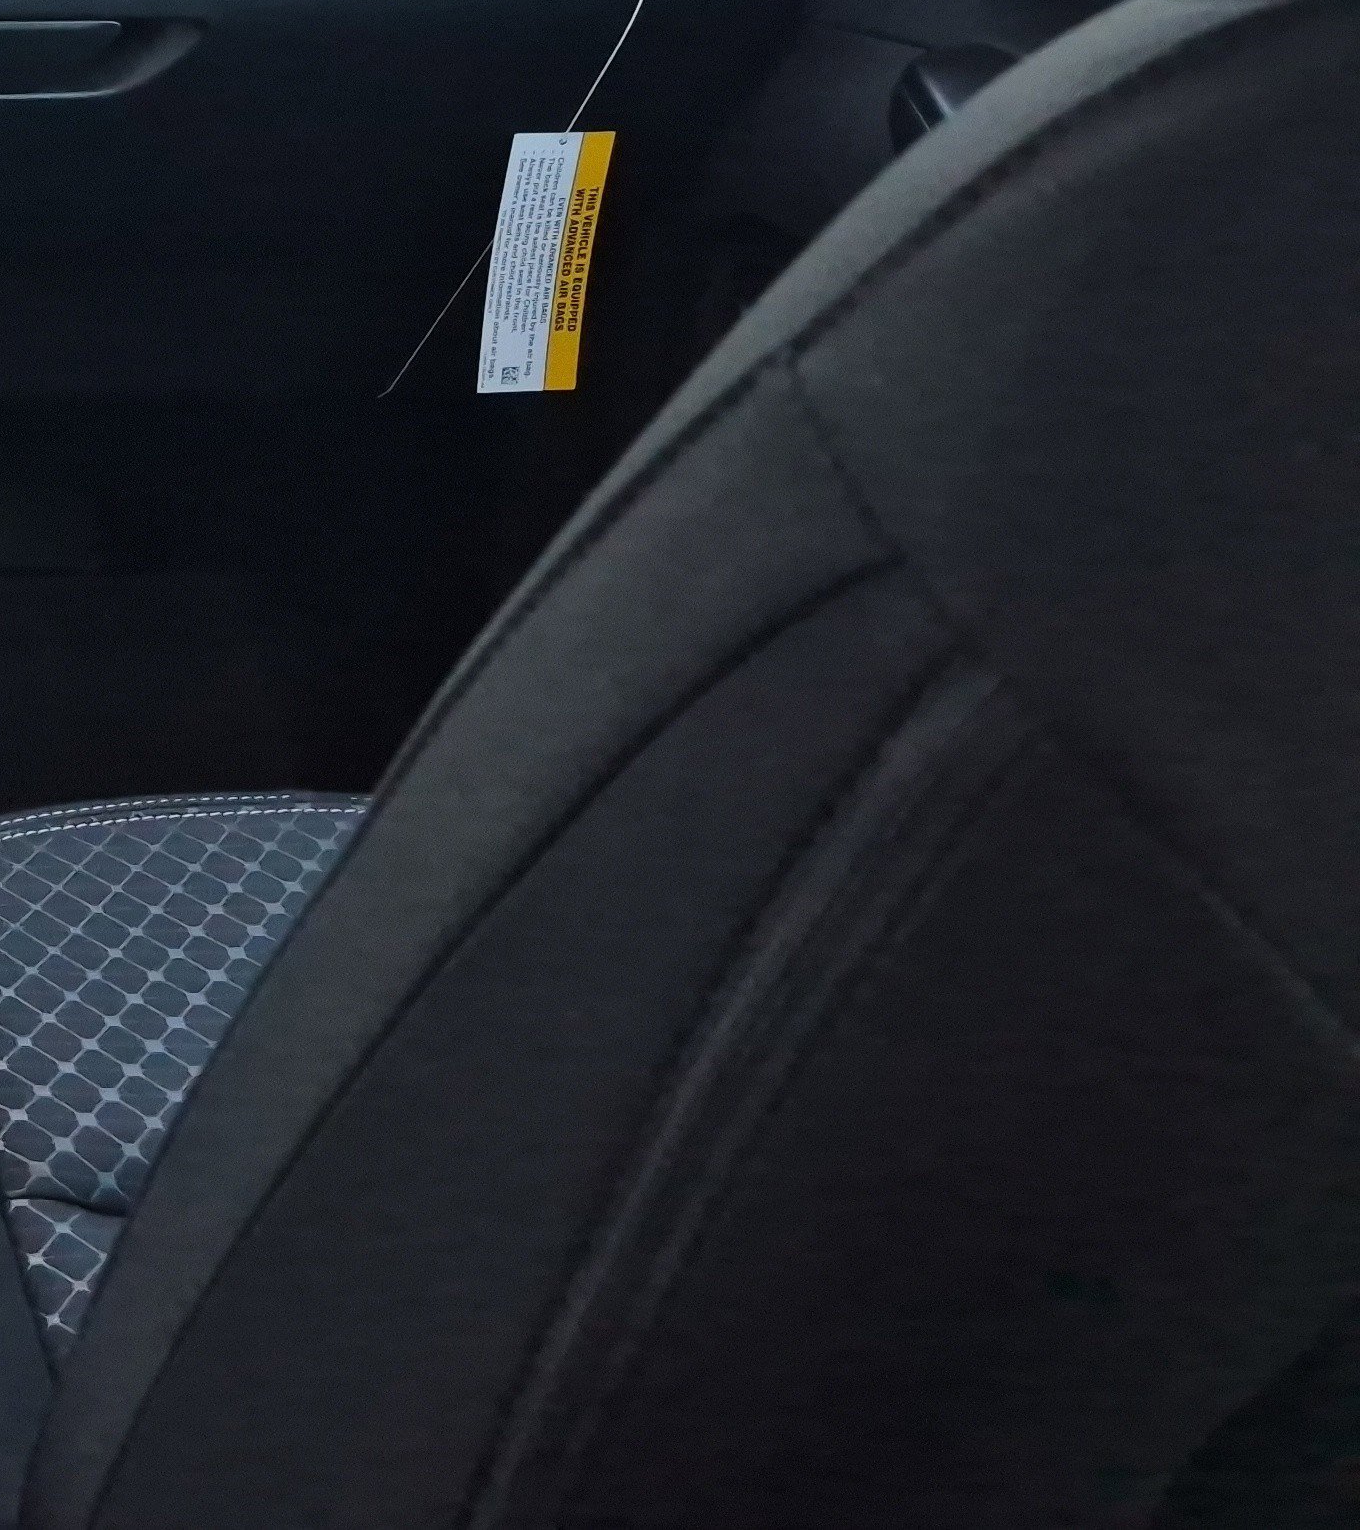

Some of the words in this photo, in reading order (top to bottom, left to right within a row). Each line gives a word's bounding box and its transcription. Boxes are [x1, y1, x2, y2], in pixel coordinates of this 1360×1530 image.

[571, 188, 585, 215] WITH
[585, 187, 599, 210] THIS
[561, 218, 580, 276] ADVANCED
[576, 214, 594, 259] VEHICLE
[574, 263, 585, 273] IS
[558, 280, 570, 297] AIR
[552, 302, 567, 331] BAGS
[565, 277, 583, 331] EQUIPPED
